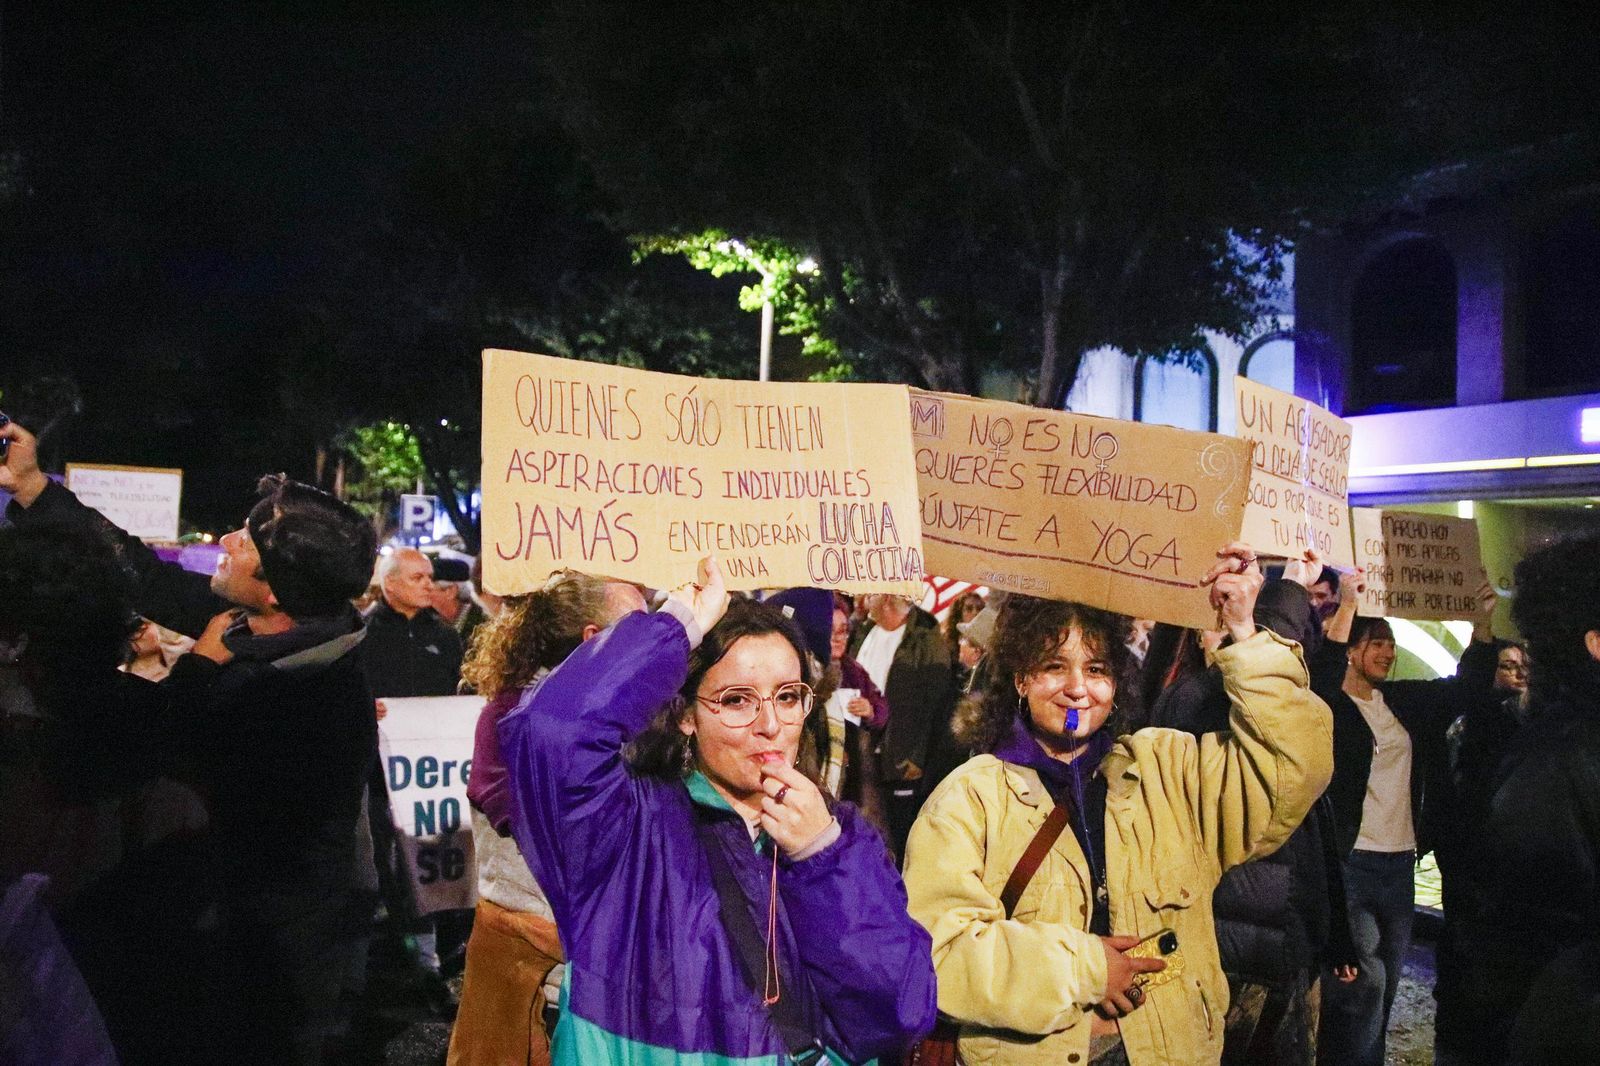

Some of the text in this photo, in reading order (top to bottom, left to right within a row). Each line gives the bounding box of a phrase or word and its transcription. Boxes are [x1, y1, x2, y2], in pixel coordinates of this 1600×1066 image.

[515, 374, 825, 451] QUIENES SÓLO TIENEN
[1240, 390, 1273, 433] UN
[968, 414, 1120, 472] NO ES NO
[506, 448, 871, 500] ASPIRACIONES INDIVIDUALES
[916, 448, 1198, 512] QUIERES FLEXIBILIDAD
[1243, 435, 1265, 468] O
[1271, 444, 1300, 478] DEJA
[1319, 462, 1347, 500] SERLO
[495, 498, 900, 563] JAMÁS ENTENDERÁN LUCHA
[919, 491, 1183, 576] ÚNTATE A YOGA
[1271, 518, 1289, 546] TU
[1328, 504, 1340, 526] ES
[726, 543, 925, 584] UNA COLECTIVA
[1365, 539, 1389, 556] CON
[1396, 543, 1417, 558] MIS
[1366, 562, 1394, 582] PARA
[1448, 571, 1464, 586] NO
[1366, 589, 1476, 612] MARCHAR POR ELLAS
[414, 797, 461, 837] NO
